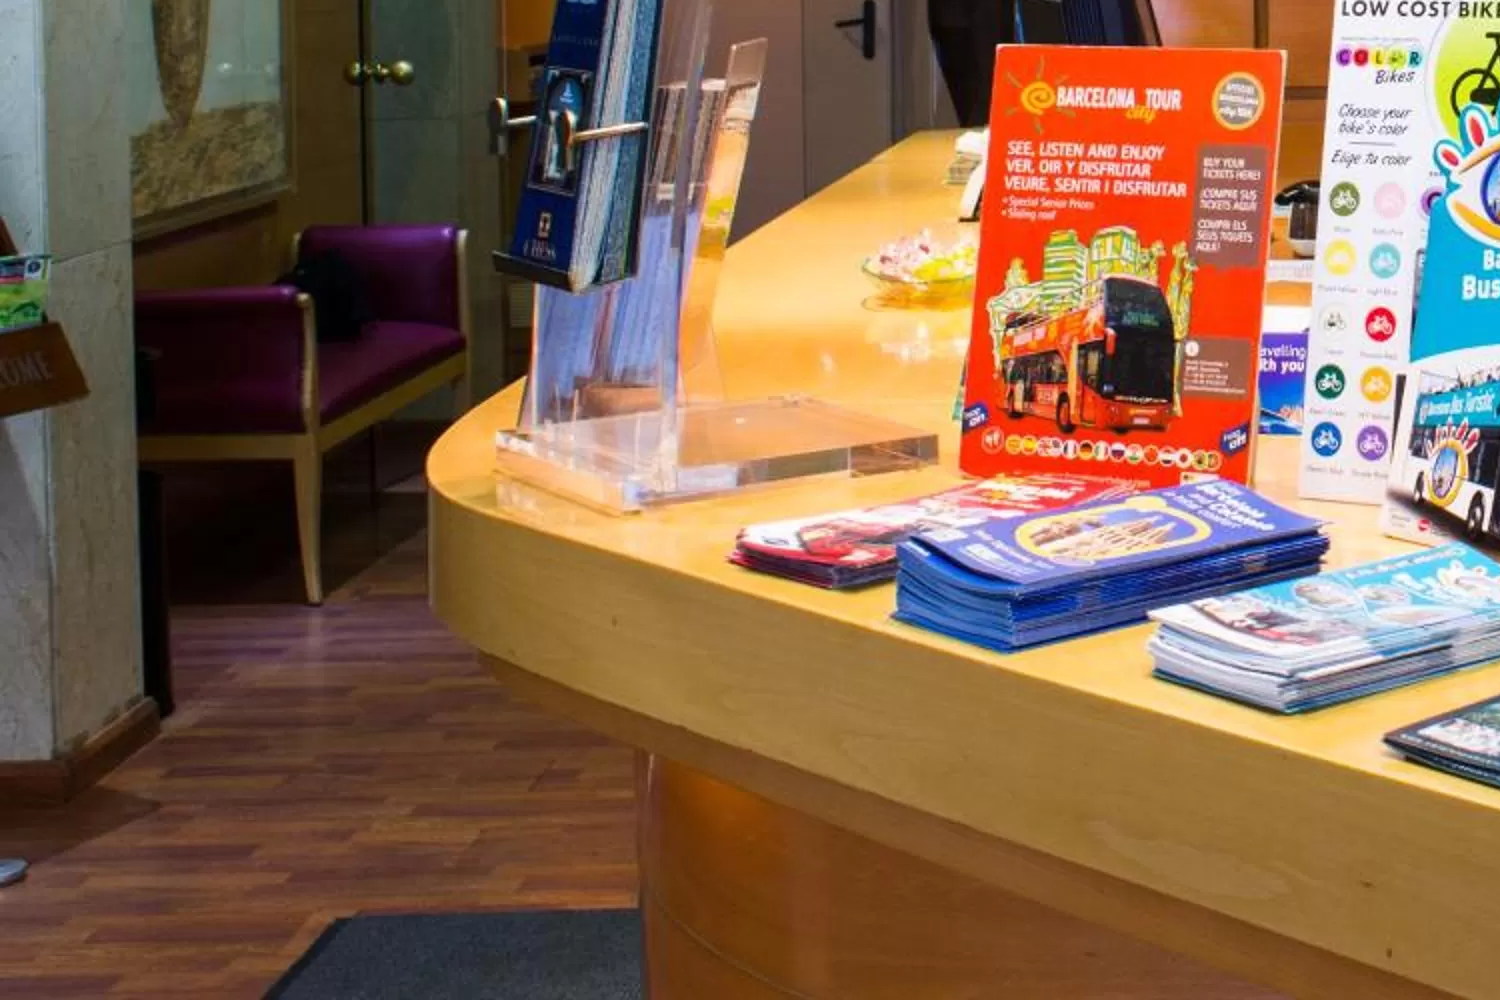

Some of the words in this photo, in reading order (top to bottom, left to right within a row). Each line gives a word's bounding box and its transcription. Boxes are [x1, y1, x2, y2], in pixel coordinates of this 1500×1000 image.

[1341, 0, 1390, 17] LOW
[1397, 0, 1452, 18] COST
[1375, 69, 1415, 85] Bikes
[1056, 86, 1135, 109] BARCELONA
[1145, 88, 1182, 111] TOUR
[1125, 105, 1157, 123] city
[1338, 103, 1380, 119] Choose
[1383, 107, 1411, 121] your
[1378, 122, 1408, 135] color
[1039, 141, 1083, 157] LISTEN
[1087, 143, 1117, 158] AND
[1121, 144, 1165, 160] ENJOY
[1332, 150, 1364, 167] Elige
[1385, 154, 1411, 166] color
[1039, 159, 1063, 174] OIR
[1066, 160, 1077, 175] Y
[1079, 161, 1152, 178] DISFRUTAR
[1054, 177, 1101, 193] SENTIR
[1113, 181, 1188, 197] DISFRUTAR
[1260, 343, 1306, 359] avelling
[1281, 361, 1305, 374] you
